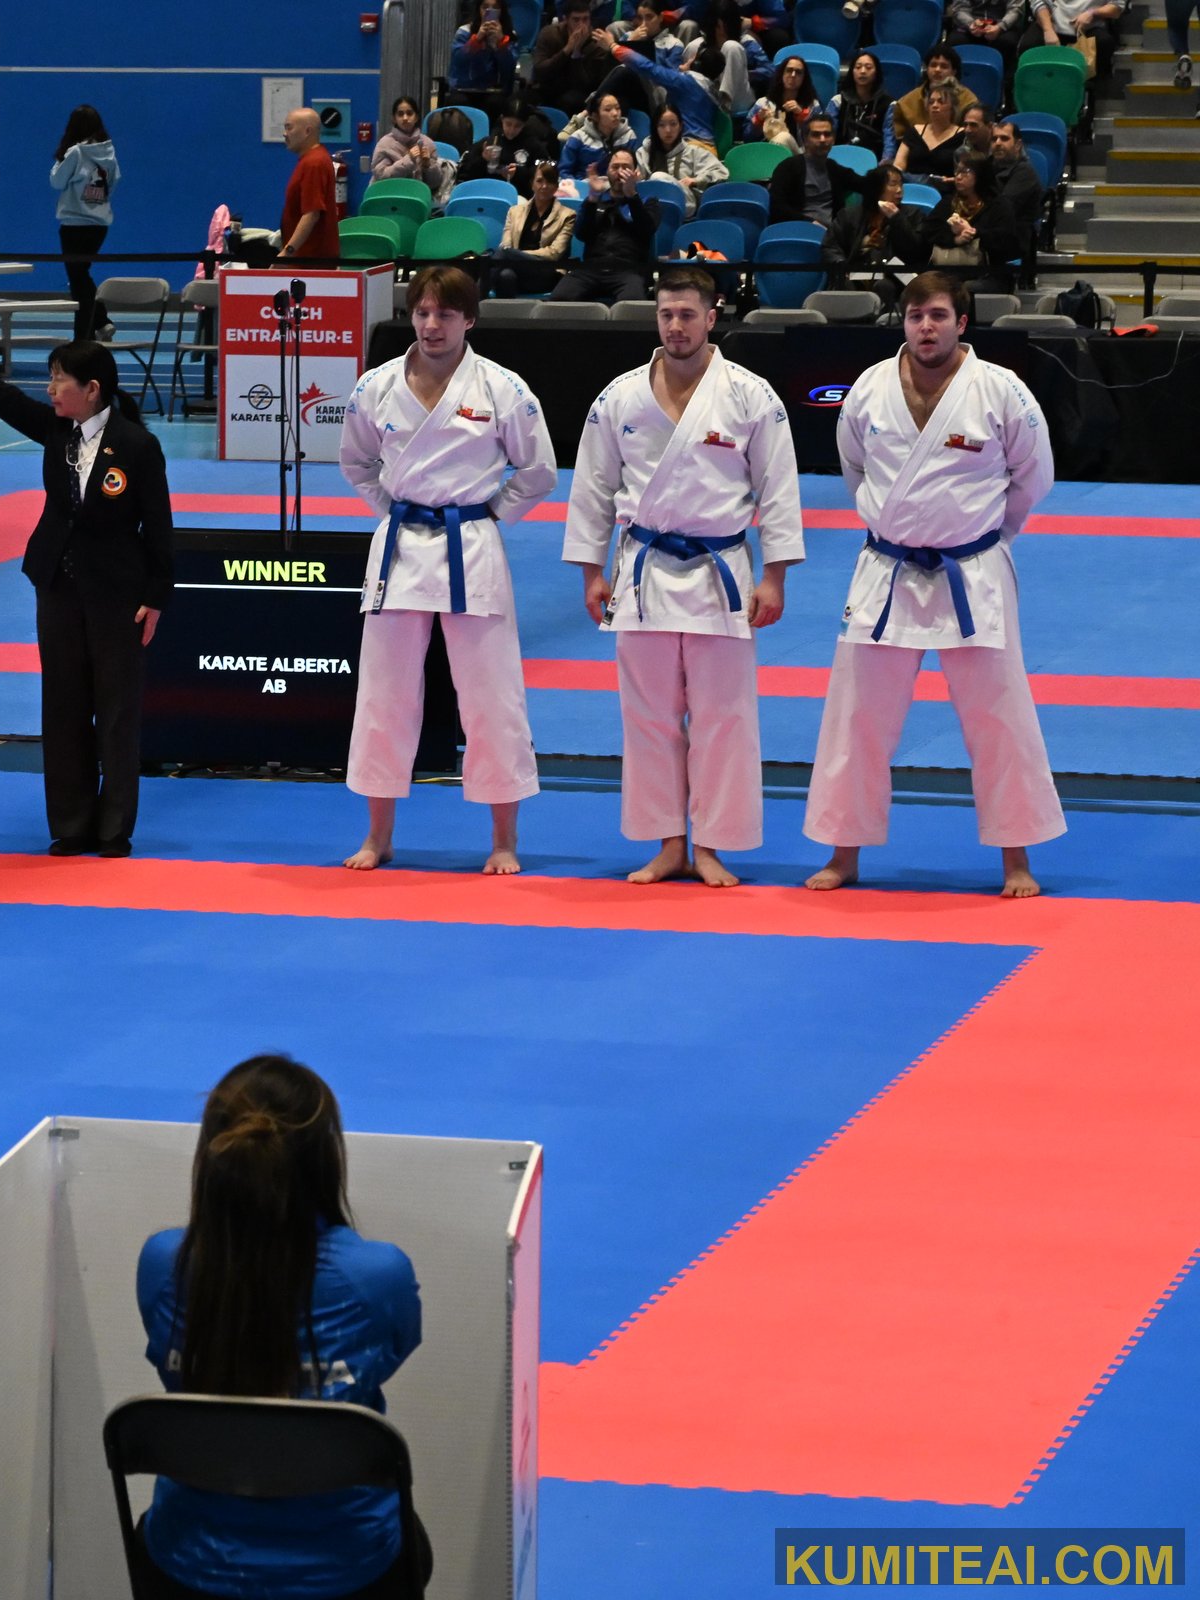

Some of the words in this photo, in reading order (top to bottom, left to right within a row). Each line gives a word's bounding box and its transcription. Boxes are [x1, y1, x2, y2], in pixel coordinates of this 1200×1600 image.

[231, 413, 273, 422] KARATE
[315, 405, 346, 415] KARAT
[223, 559, 327, 583] WINNER
[199, 655, 268, 672] KARATE
[271, 657, 352, 674] ALBERTA
[261, 678, 287, 694] AB
